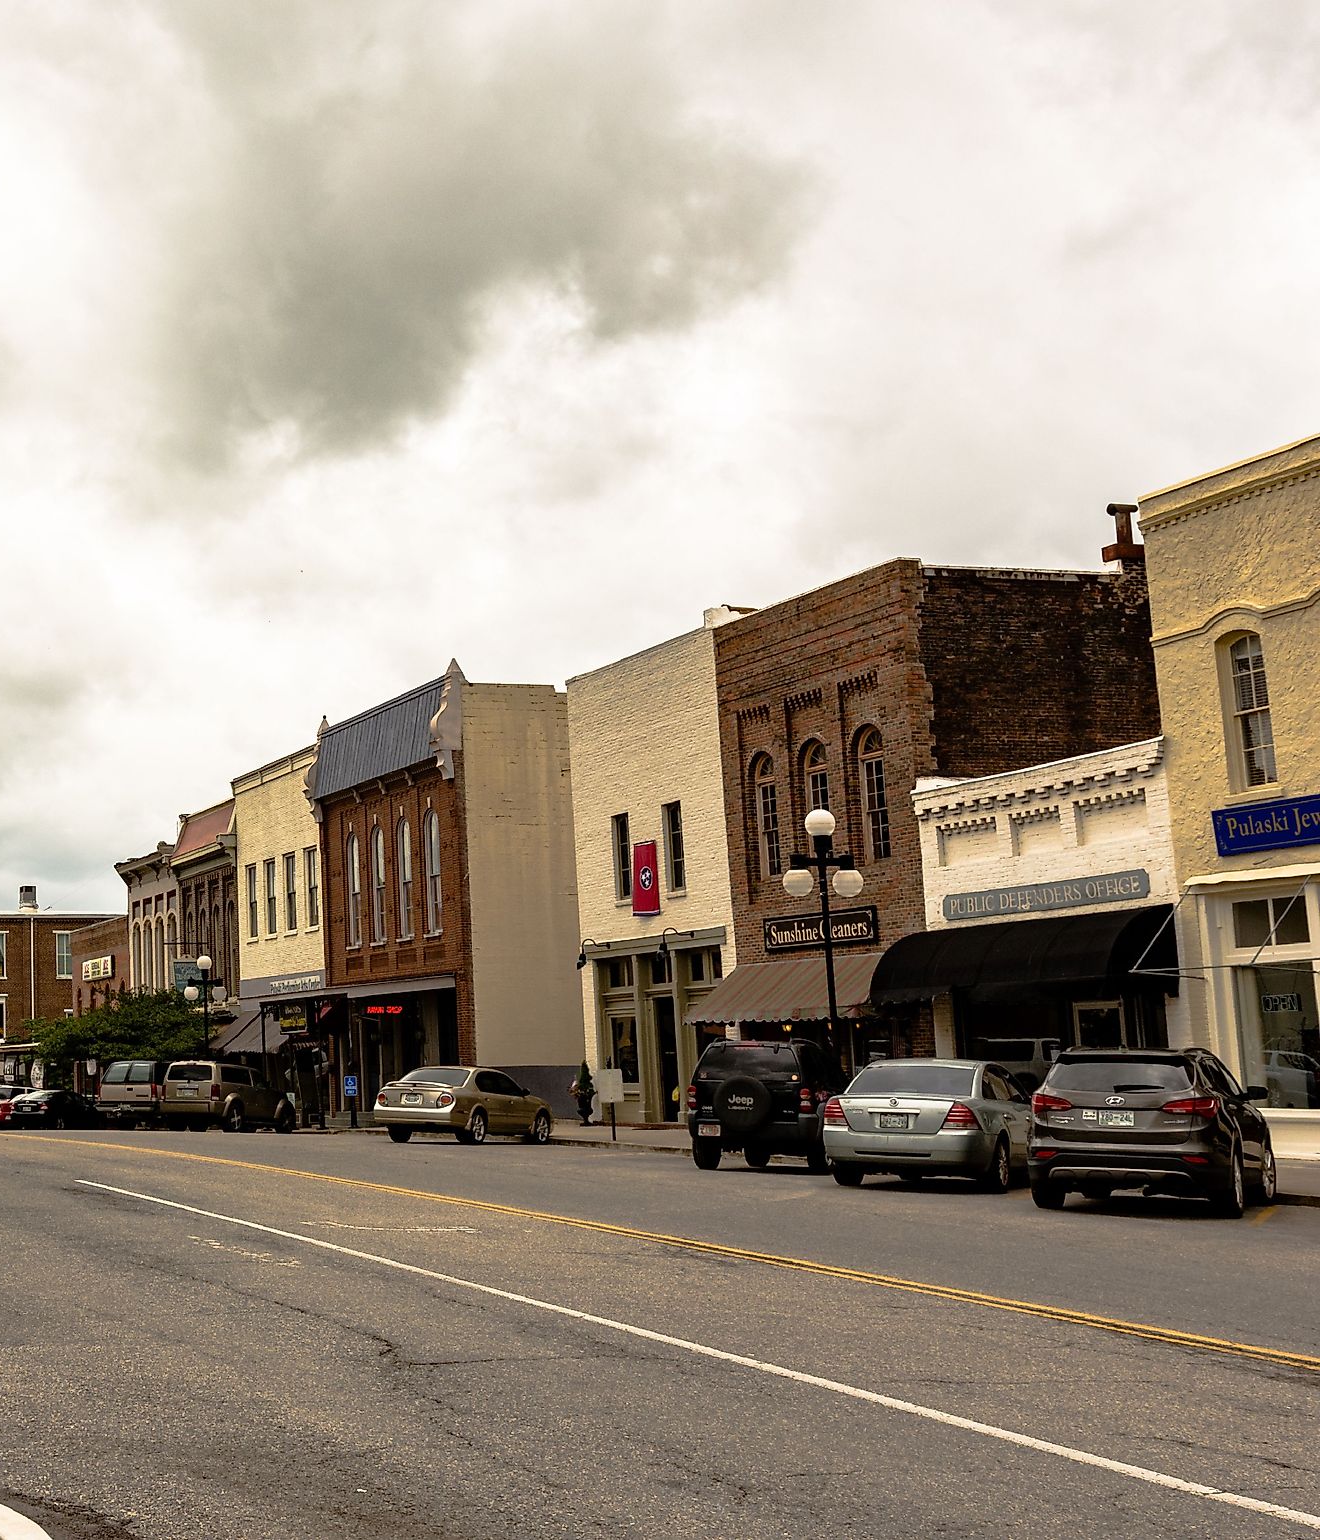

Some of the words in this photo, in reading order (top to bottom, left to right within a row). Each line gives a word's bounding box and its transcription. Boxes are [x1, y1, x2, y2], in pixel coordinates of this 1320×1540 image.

[1225, 809, 1289, 839] Pulaski
[950, 895, 995, 915] PUBLIC
[999, 884, 1082, 910] DEFENDERS
[1085, 875, 1141, 899] OFFICE
[770, 921, 818, 945] Sunshine
[386, 1006, 403, 1014] SHOP
[1264, 995, 1297, 1011] OPEN
[728, 1094, 754, 1106] Jeep
